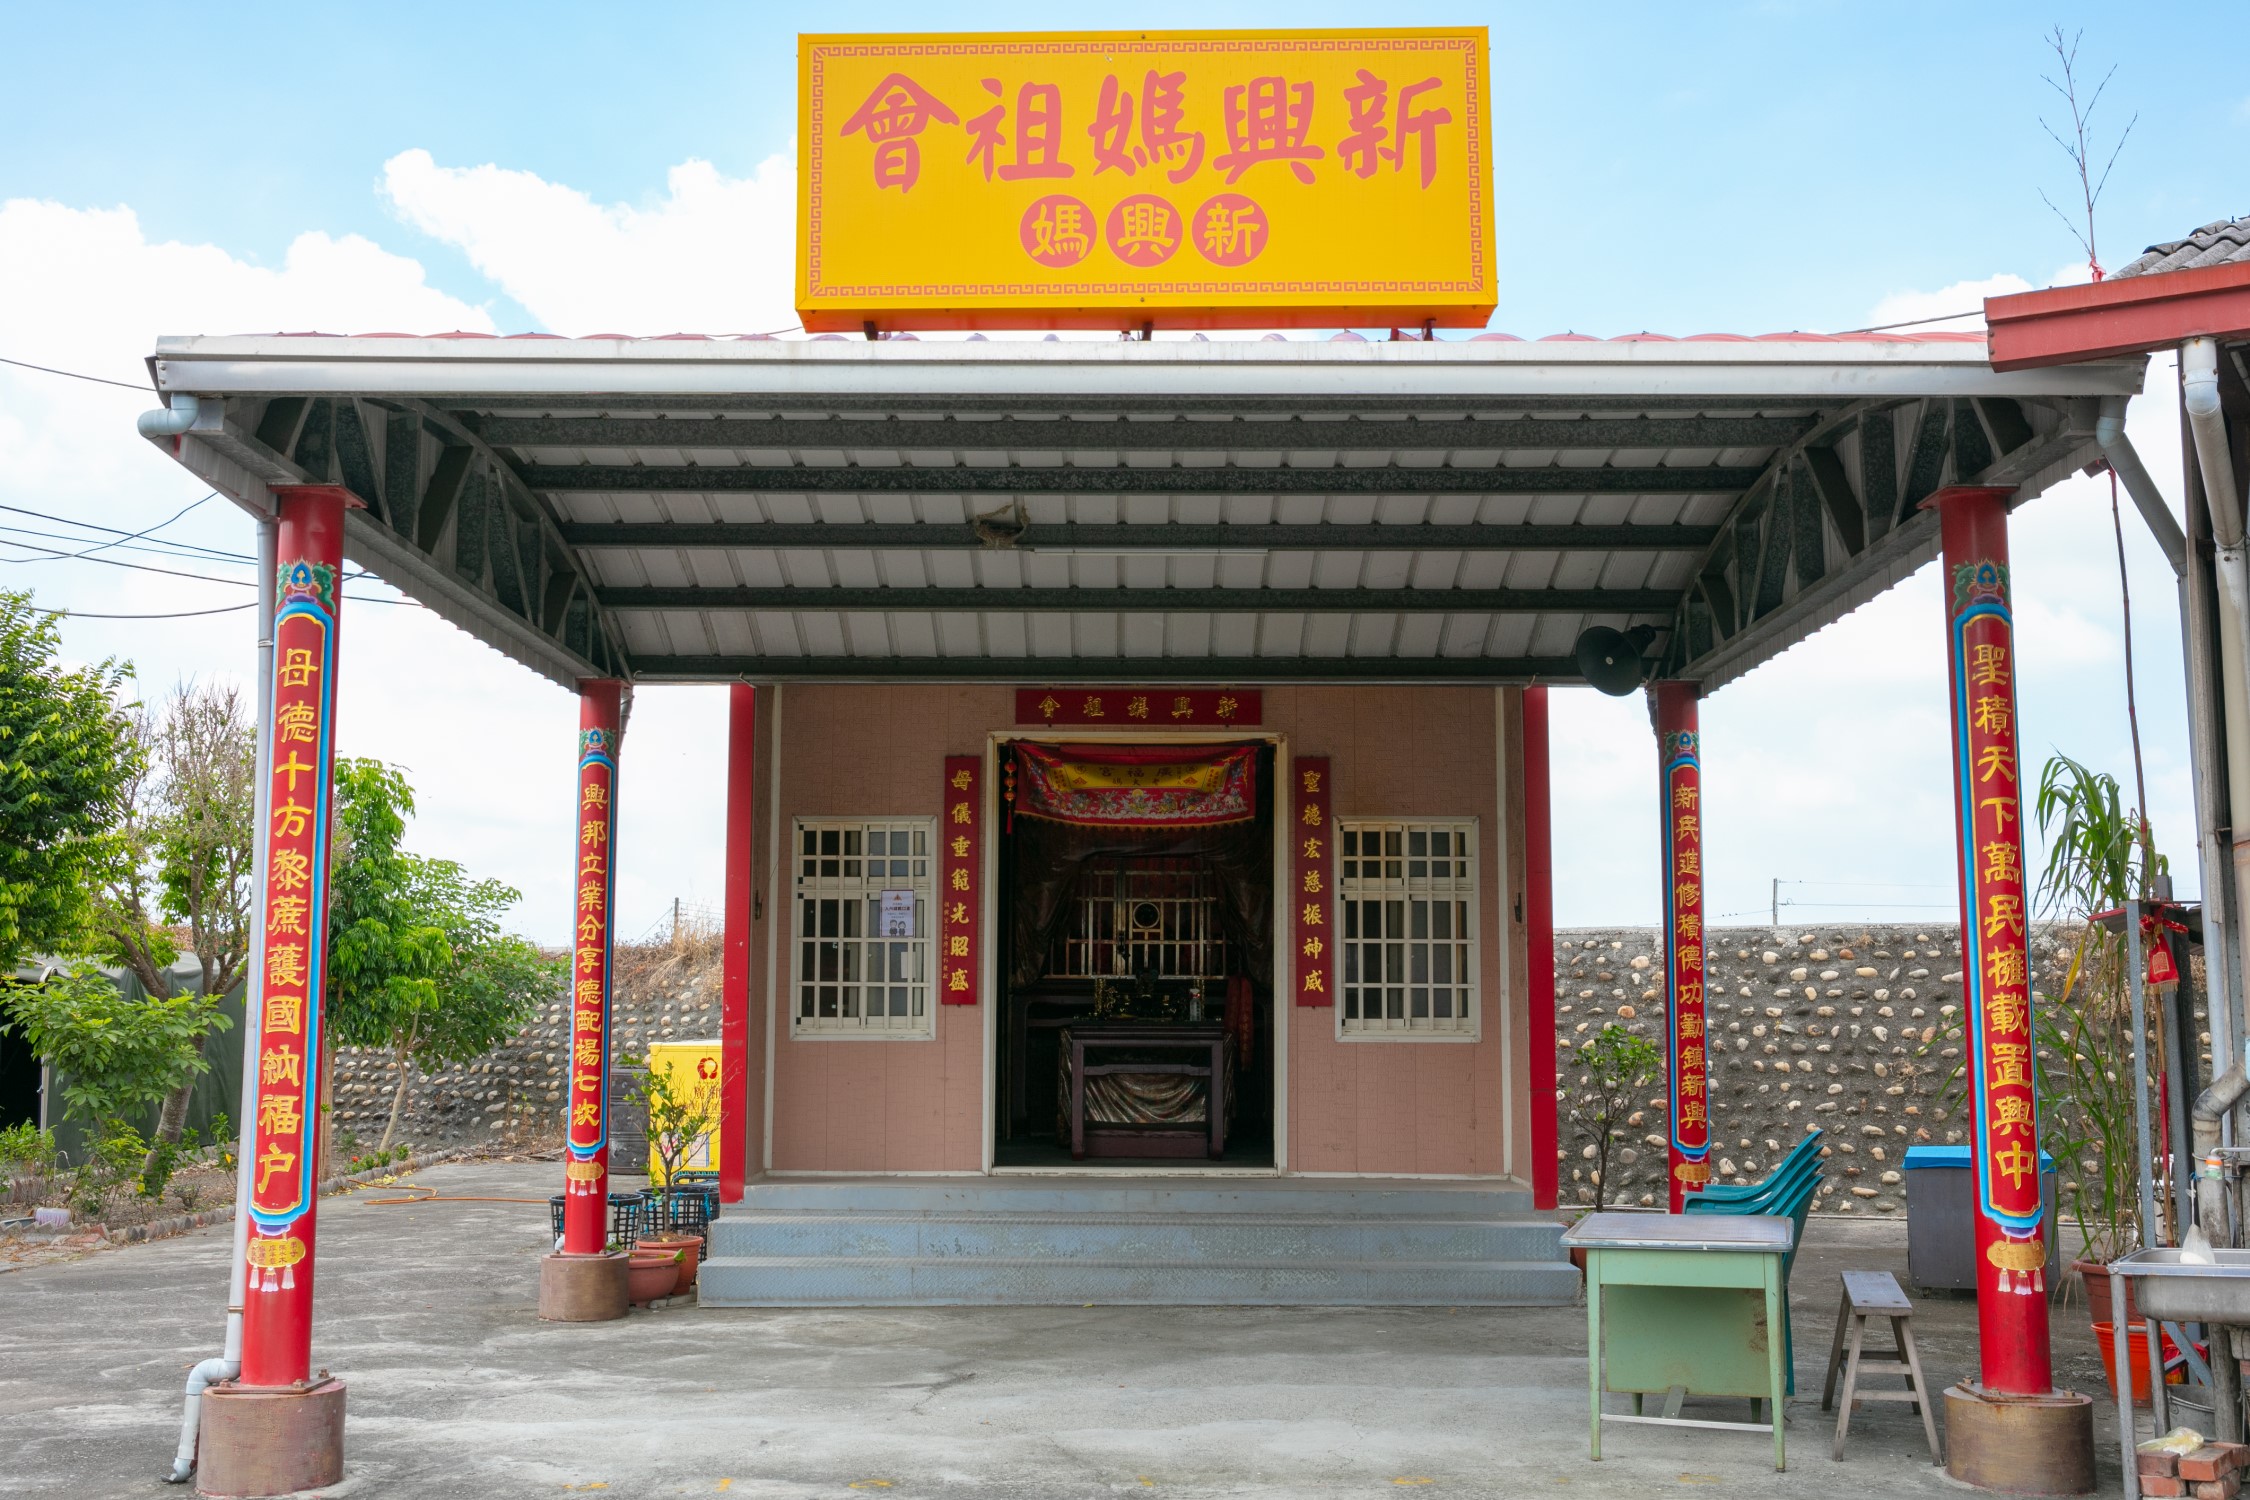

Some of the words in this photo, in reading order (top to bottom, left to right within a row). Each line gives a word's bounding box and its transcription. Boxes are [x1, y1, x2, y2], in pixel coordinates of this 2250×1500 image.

[840, 69, 1453, 193] 新興媽祖會
[1027, 199, 1263, 262] 新興媽
[1038, 695, 1239, 719] 新興媽祖會
[949, 769, 973, 992] 母儀垂範光昭盛
[1302, 770, 1324, 993] 聖德宏慈振神威
